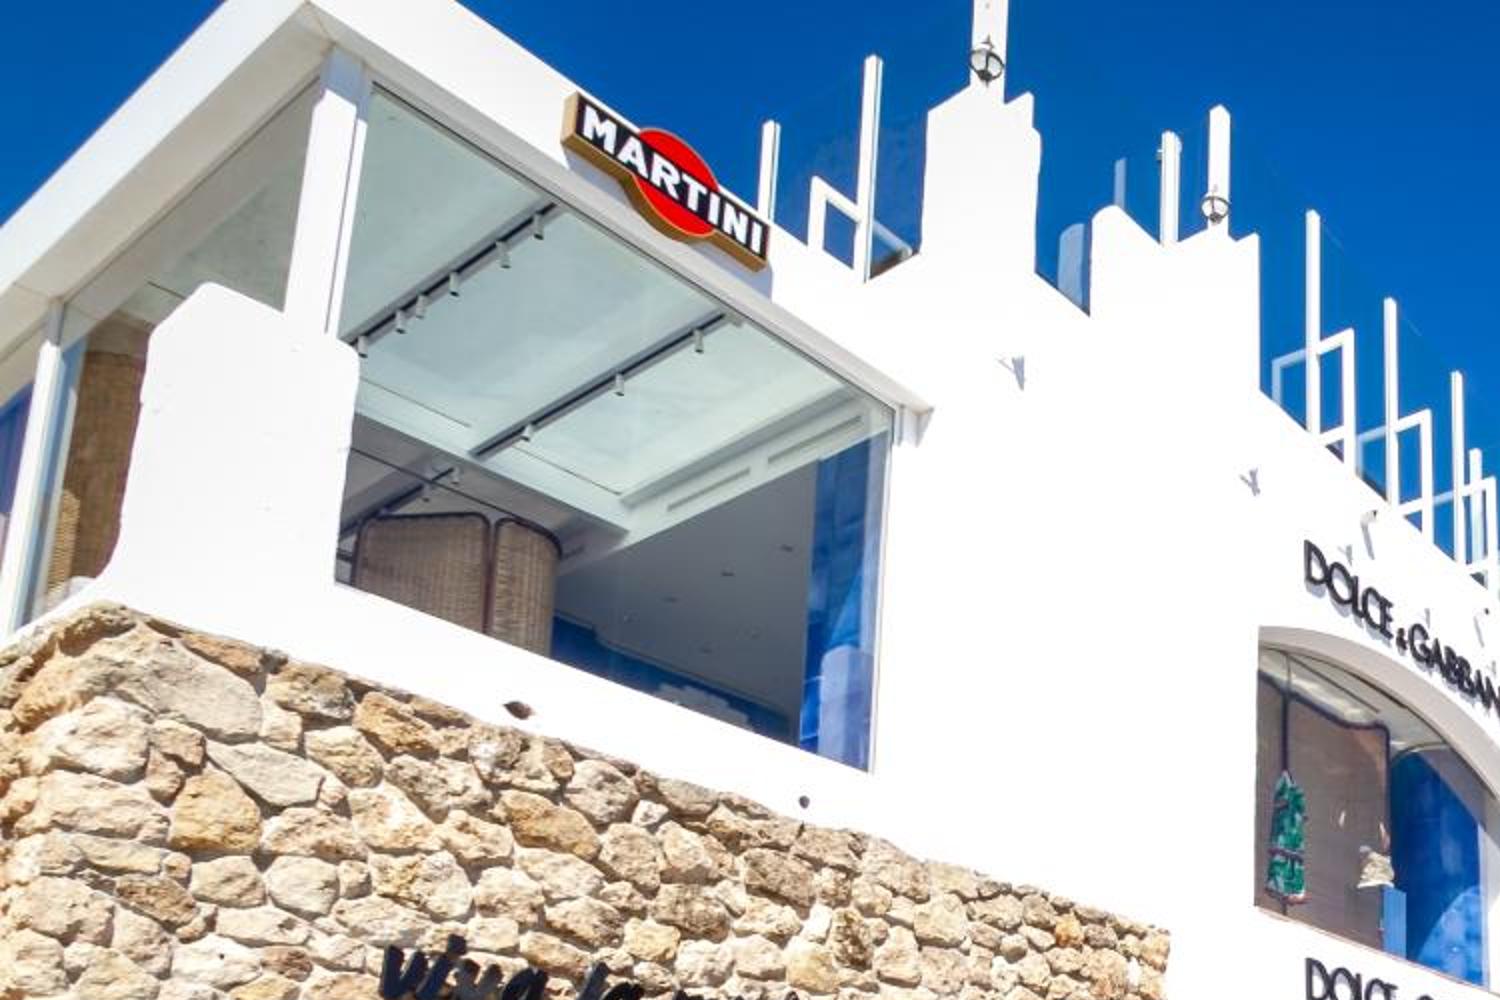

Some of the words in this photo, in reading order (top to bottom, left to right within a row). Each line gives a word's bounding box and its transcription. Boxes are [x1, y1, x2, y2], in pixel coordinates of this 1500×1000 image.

[582, 104, 763, 254] MARTINI
[1304, 539, 1394, 639] DOLCE
[1396, 628, 1407, 651] &
